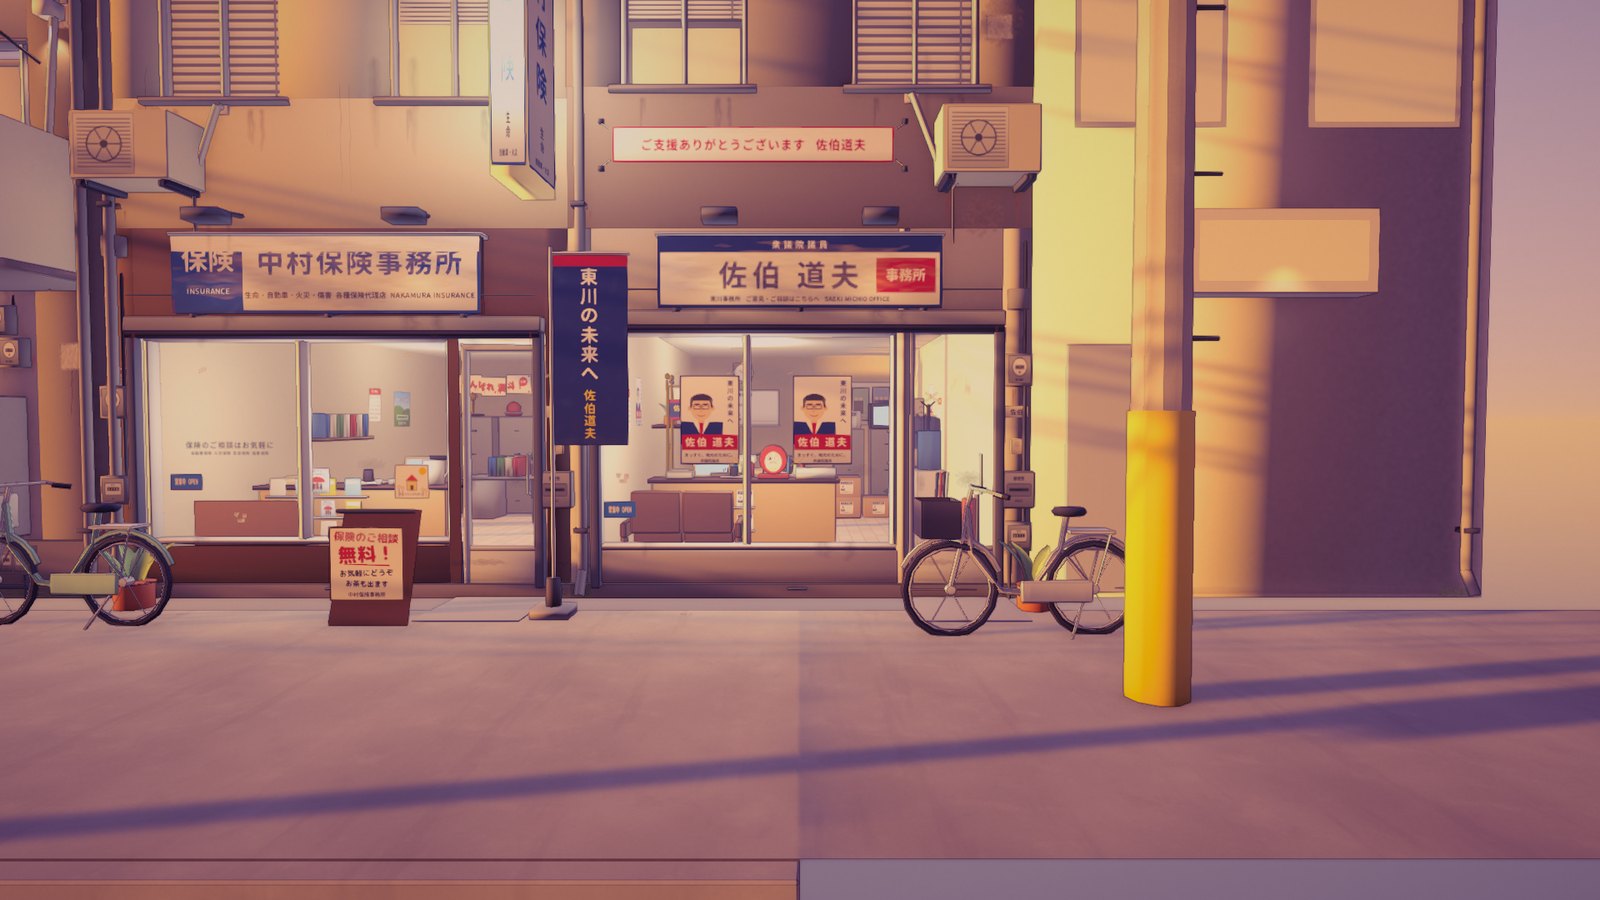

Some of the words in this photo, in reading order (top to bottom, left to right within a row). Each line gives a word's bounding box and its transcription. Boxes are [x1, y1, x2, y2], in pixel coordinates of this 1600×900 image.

[641, 138, 805, 151] ご支援ありがとうございます
[816, 138, 866, 152] 佐伯道夫
[772, 240, 828, 250] 衆議院議員
[181, 250, 234, 273] 保険
[258, 251, 462, 276] 中村保険事務所
[719, 261, 780, 289] 佐伯
[797, 261, 858, 289] 道夫
[886, 267, 926, 283] 事務所
[186, 287, 231, 295] INSURANCE
[390, 291, 432, 299] NAKAMURA
[433, 291, 475, 299] INSURANCE
[580, 268, 599, 380] 東川の未来へ
[583, 389, 597, 440] 佐伯道夫
[685, 437, 707, 448] 佐伯
[712, 437, 735, 448] 道夫
[797, 437, 820, 448] 佐伯
[825, 437, 847, 448] 道夫
[334, 532, 399, 543] 保険のご相談
[338, 545, 388, 564] 無料！
[340, 569, 393, 577] お気軽にどうぞ
